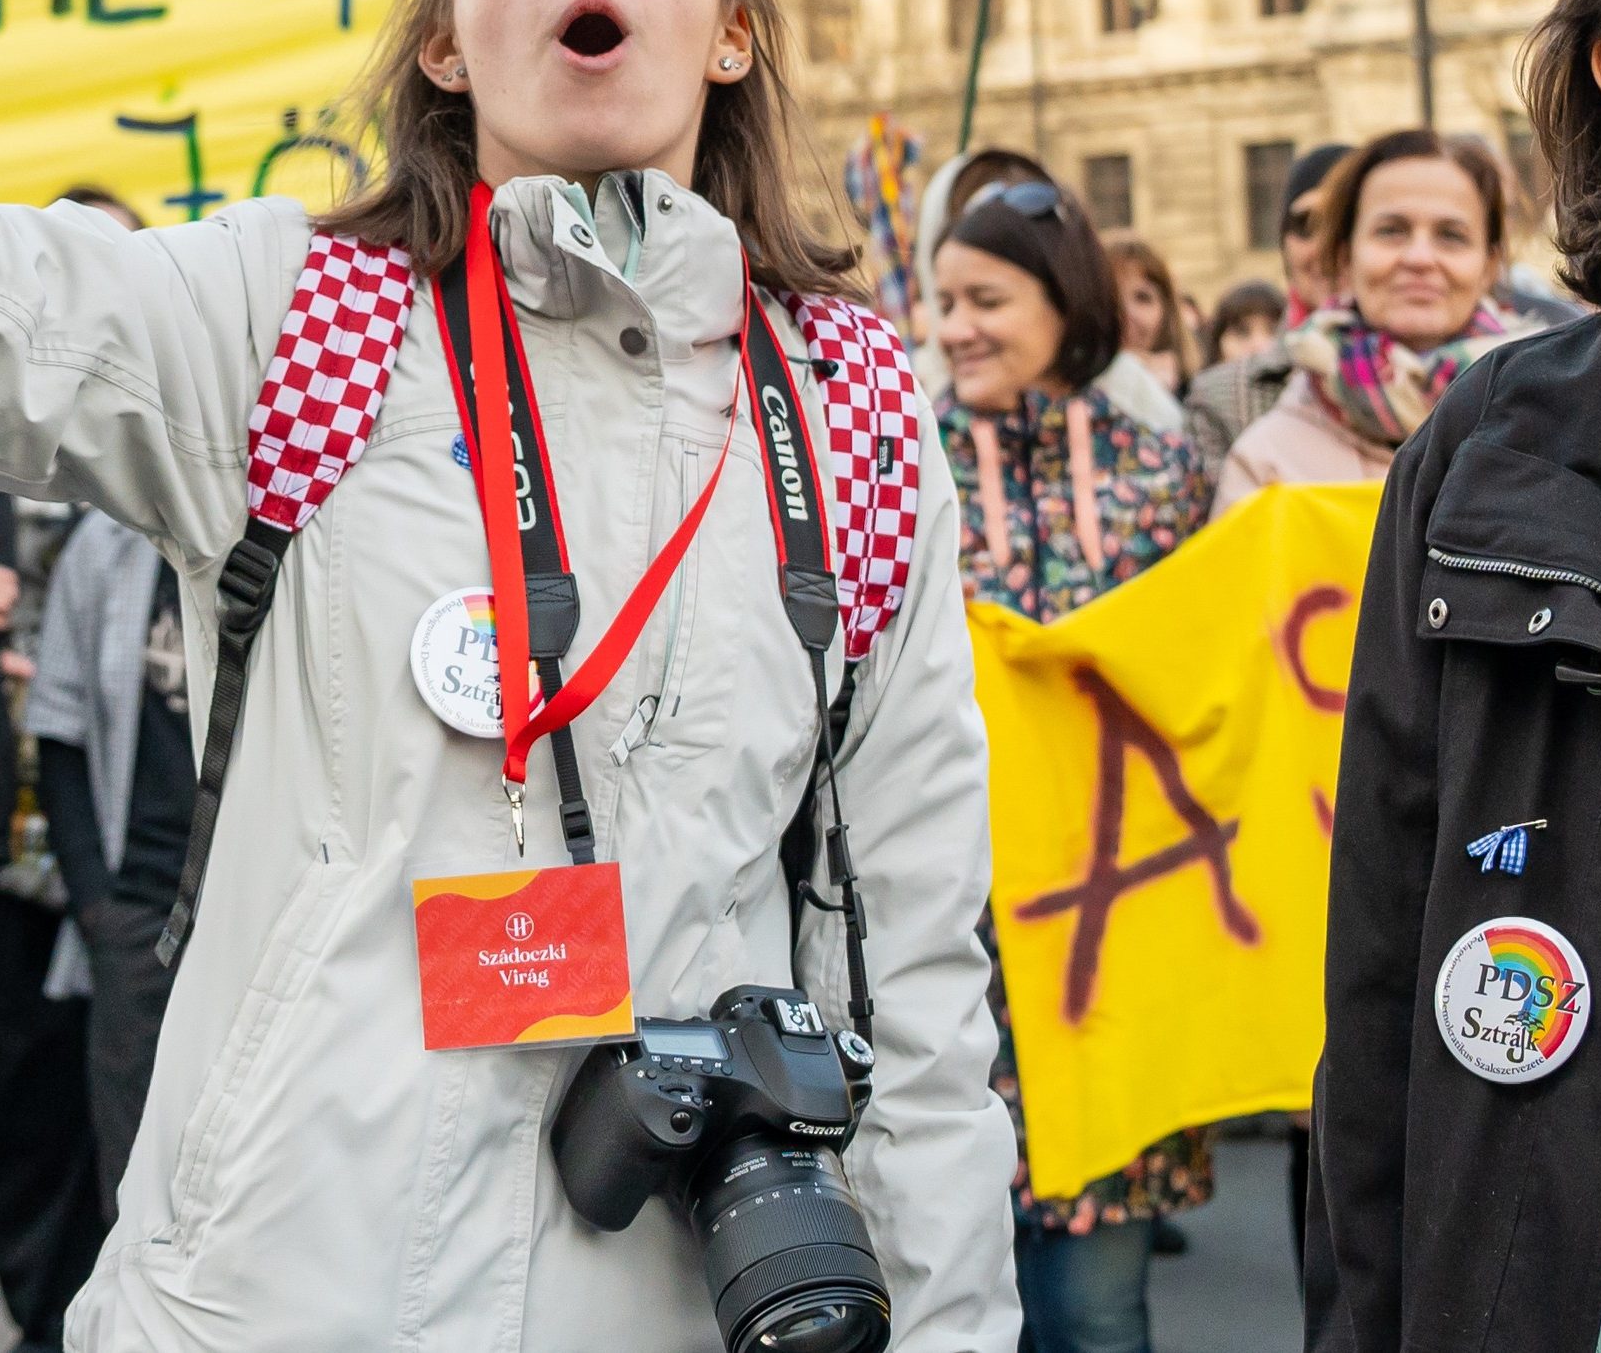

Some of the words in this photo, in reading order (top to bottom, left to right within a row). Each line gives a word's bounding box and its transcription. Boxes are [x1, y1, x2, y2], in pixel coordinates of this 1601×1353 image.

[762, 384, 809, 521] Canon
[1013, 663, 1262, 1025] A
[478, 943, 566, 966] Szádoczki
[499, 968, 550, 988] Virág
[1474, 963, 1586, 1014] PDSZ
[1442, 994, 1474, 1062] Demokratikus
[1461, 1007, 1539, 1063] Sztrájk
[1474, 1056, 1545, 1075] Szakszervezete
[789, 1121, 846, 1136] Canon
[755, 1196, 764, 1205] 50
